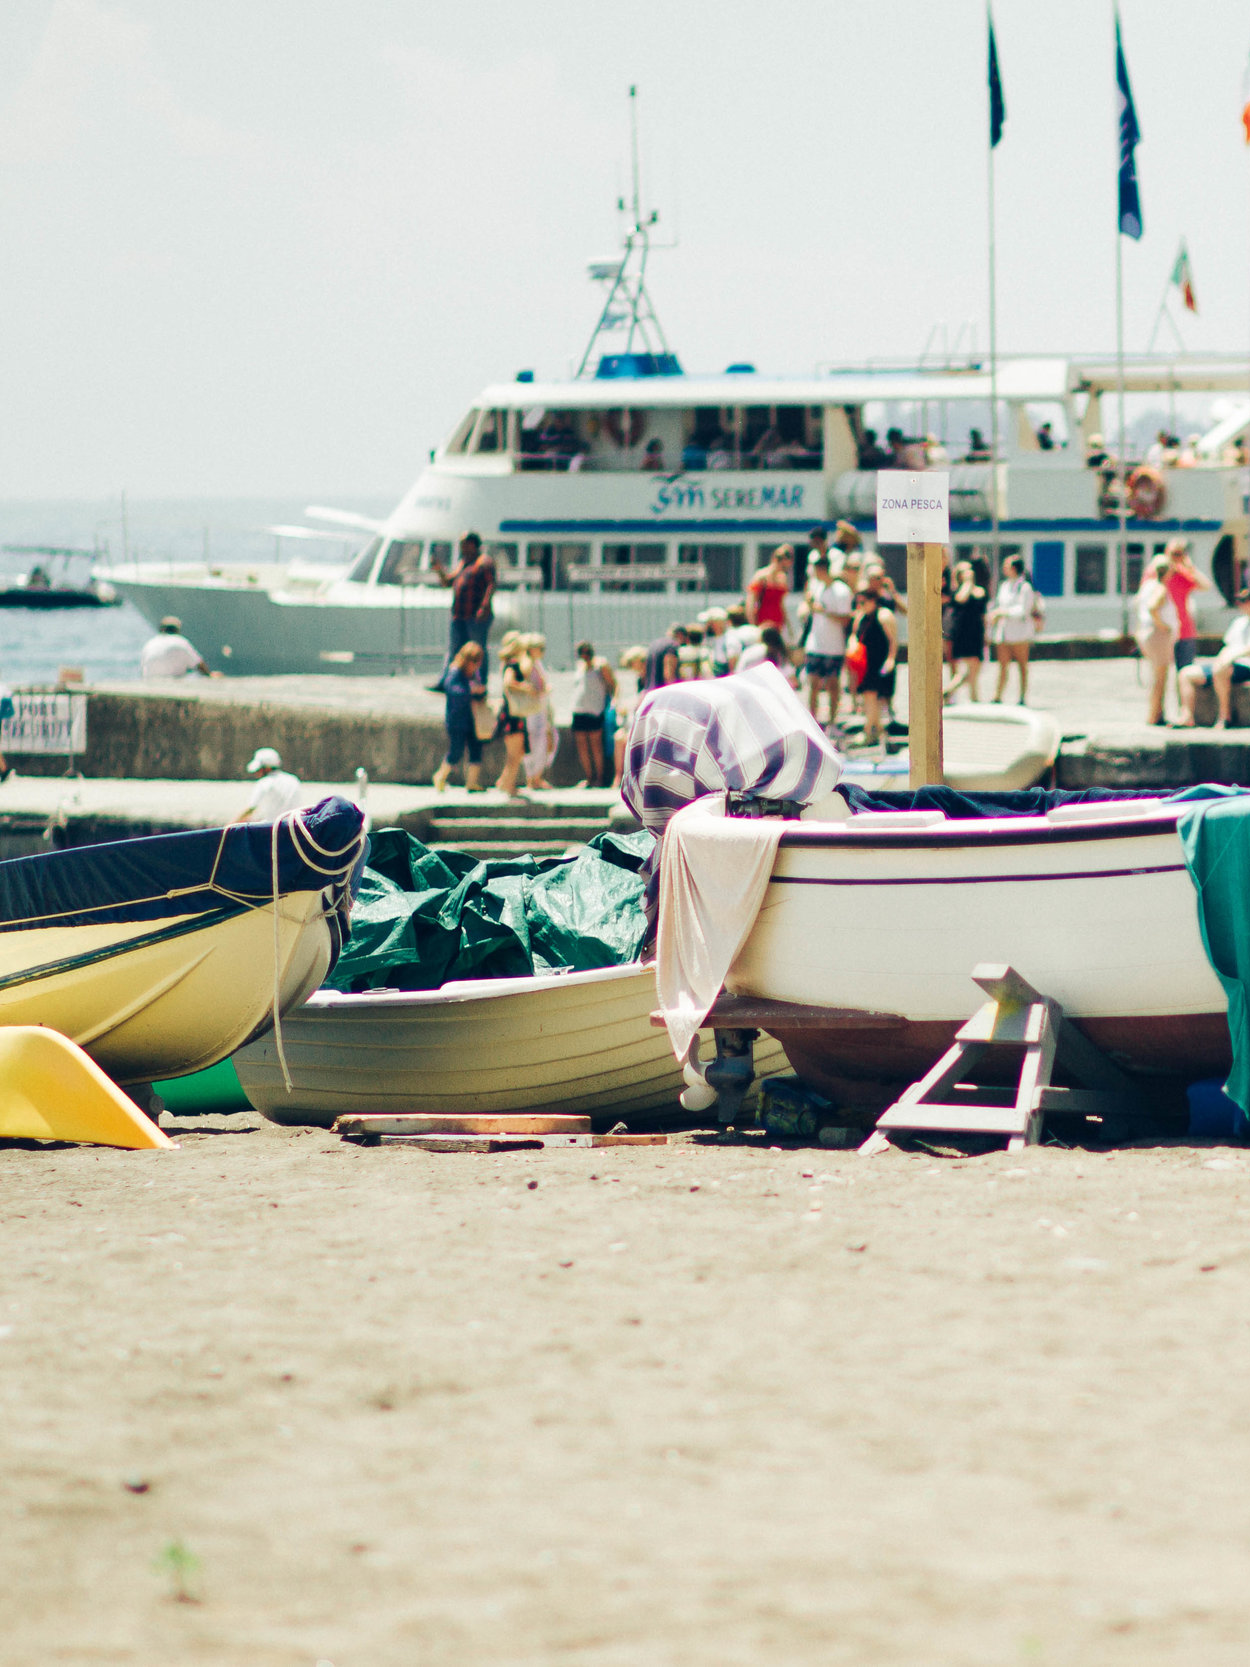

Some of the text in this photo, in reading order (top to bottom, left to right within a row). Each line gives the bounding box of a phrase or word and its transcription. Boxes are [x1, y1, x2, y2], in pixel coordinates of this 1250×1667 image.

[711, 484, 805, 510] SEREMAR
[882, 498, 943, 510] ZONA PESCA
